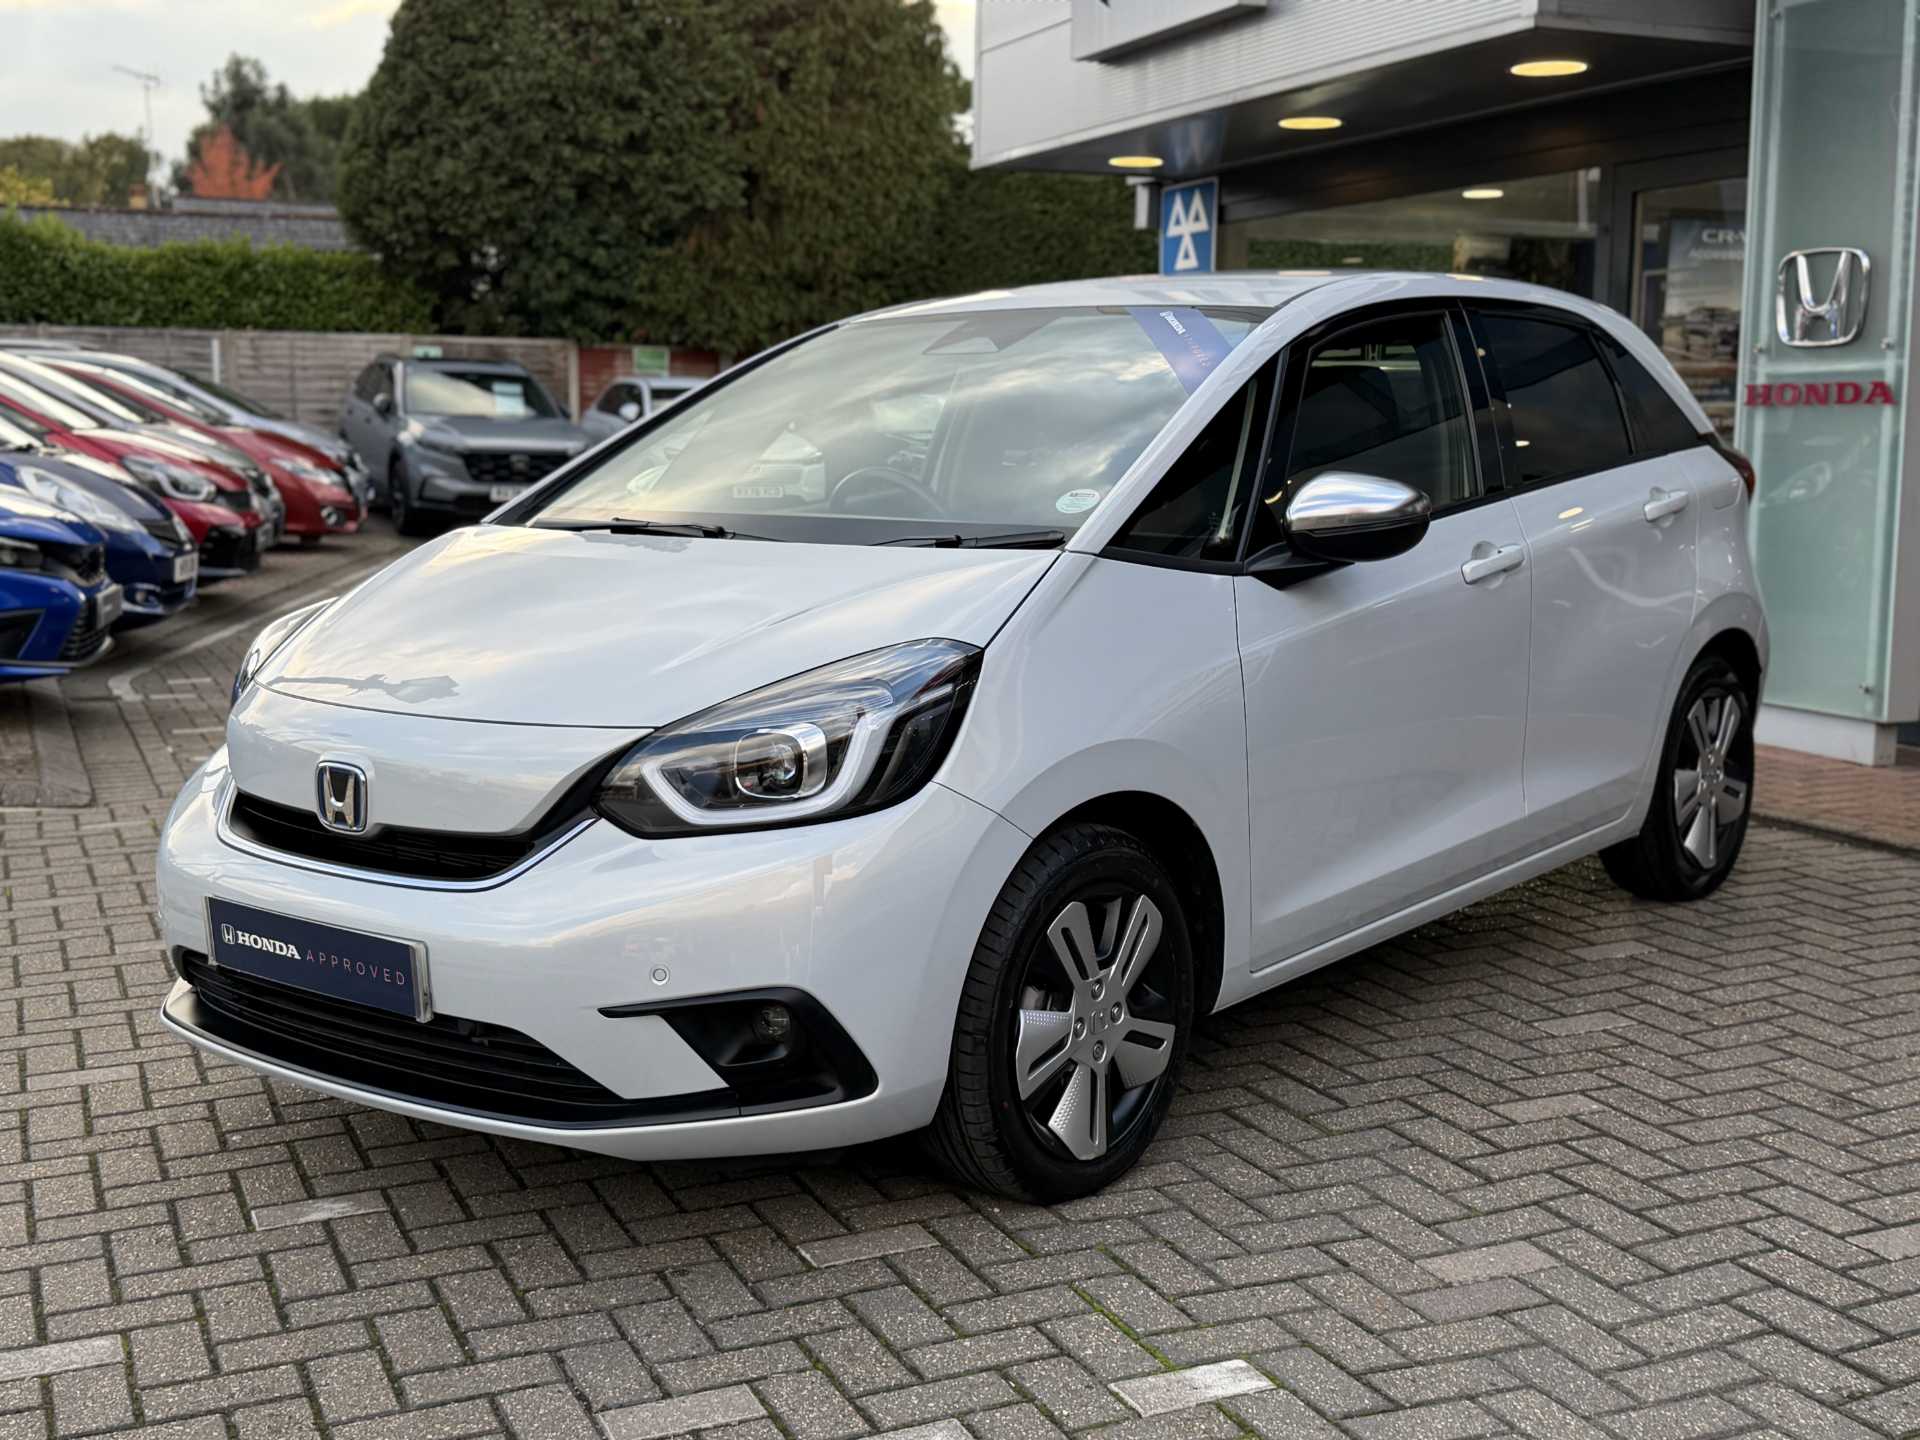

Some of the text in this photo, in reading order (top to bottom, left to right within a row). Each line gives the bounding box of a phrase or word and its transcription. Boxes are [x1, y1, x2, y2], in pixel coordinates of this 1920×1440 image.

[1745, 381, 1896, 408] HONDA
[237, 930, 405, 985] HONDA APPROVED
